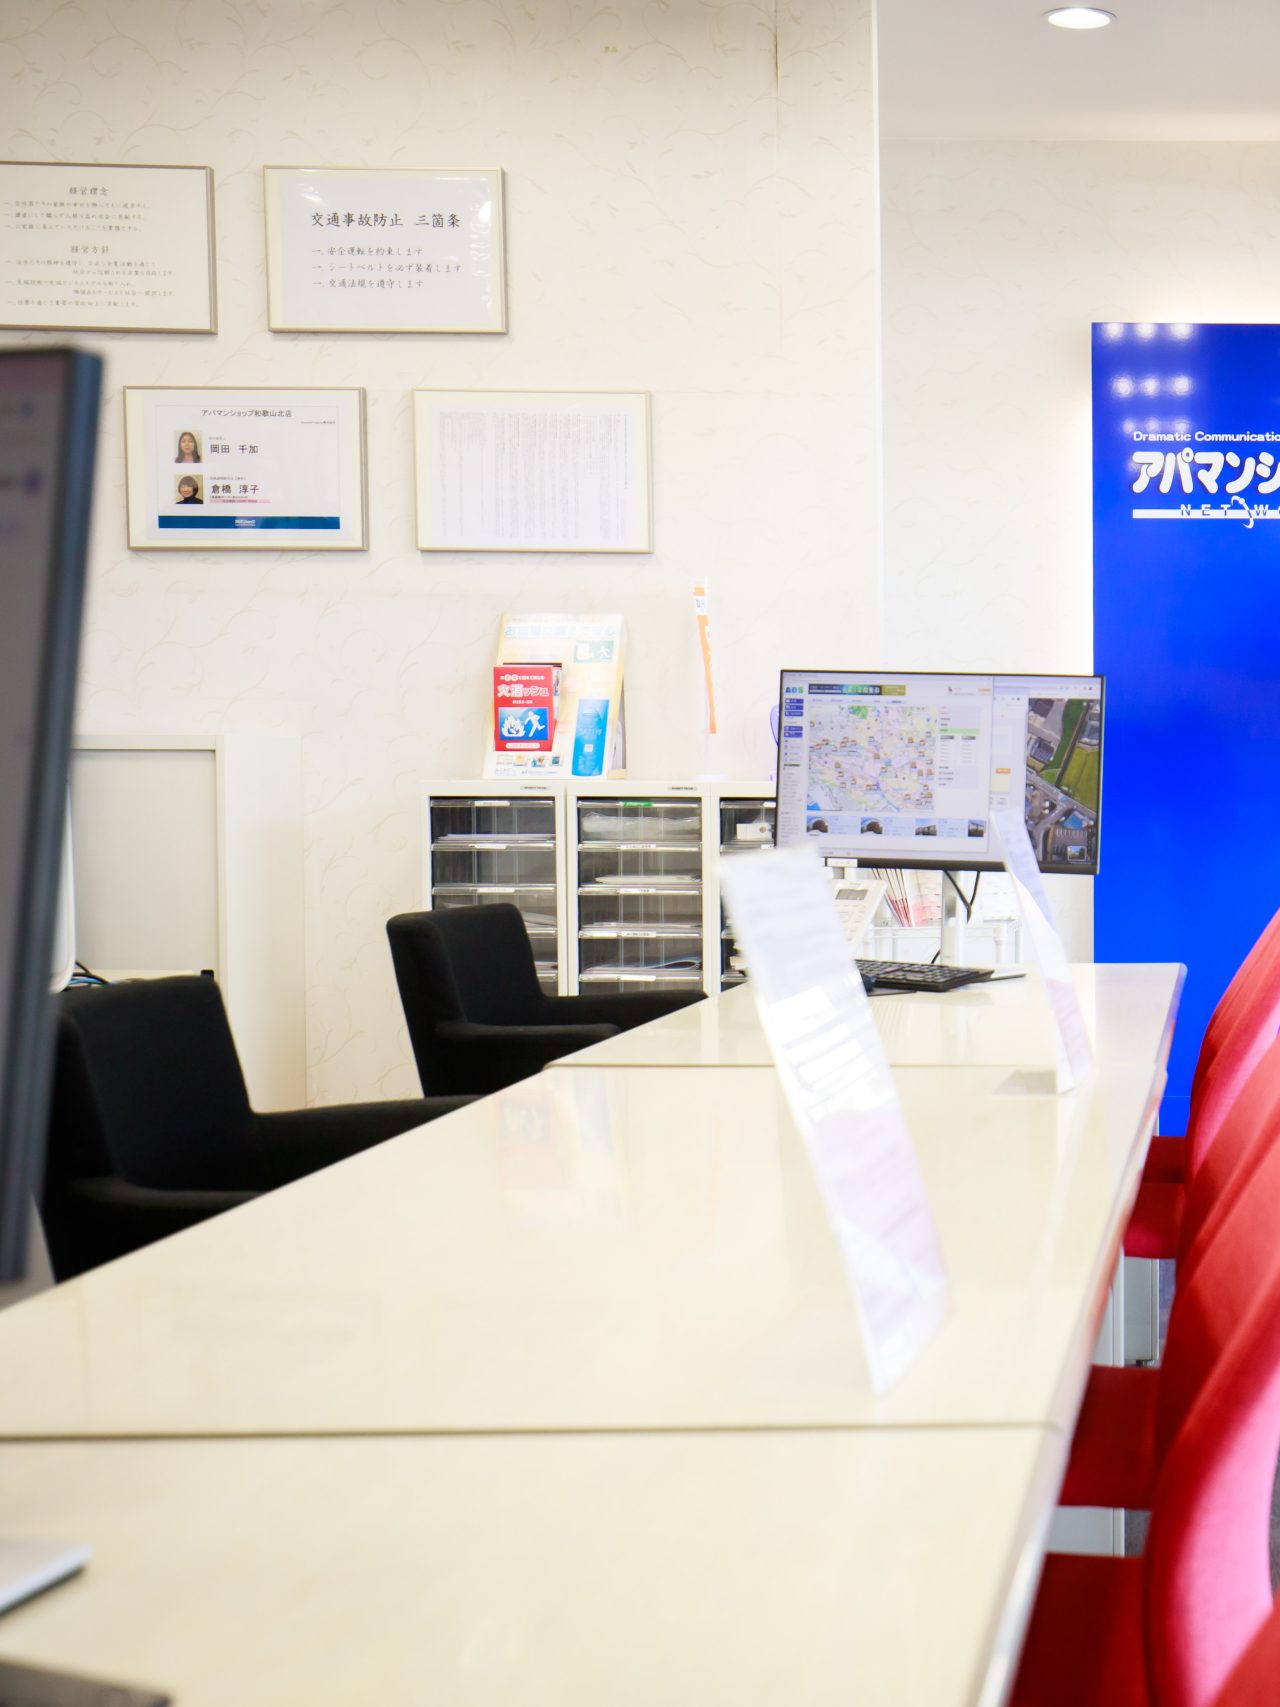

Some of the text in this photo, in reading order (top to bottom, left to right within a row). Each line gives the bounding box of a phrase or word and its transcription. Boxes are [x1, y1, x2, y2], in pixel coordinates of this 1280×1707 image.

[311, 212, 461, 228] 交通事故防止 三箇条
[201, 409, 293, 418] アパマンショップ和歌山北店
[1133, 431, 1191, 442] Dramatic
[210, 444, 259, 454] 岡田 千加
[211, 484, 260, 494] 倉橋 淳子
